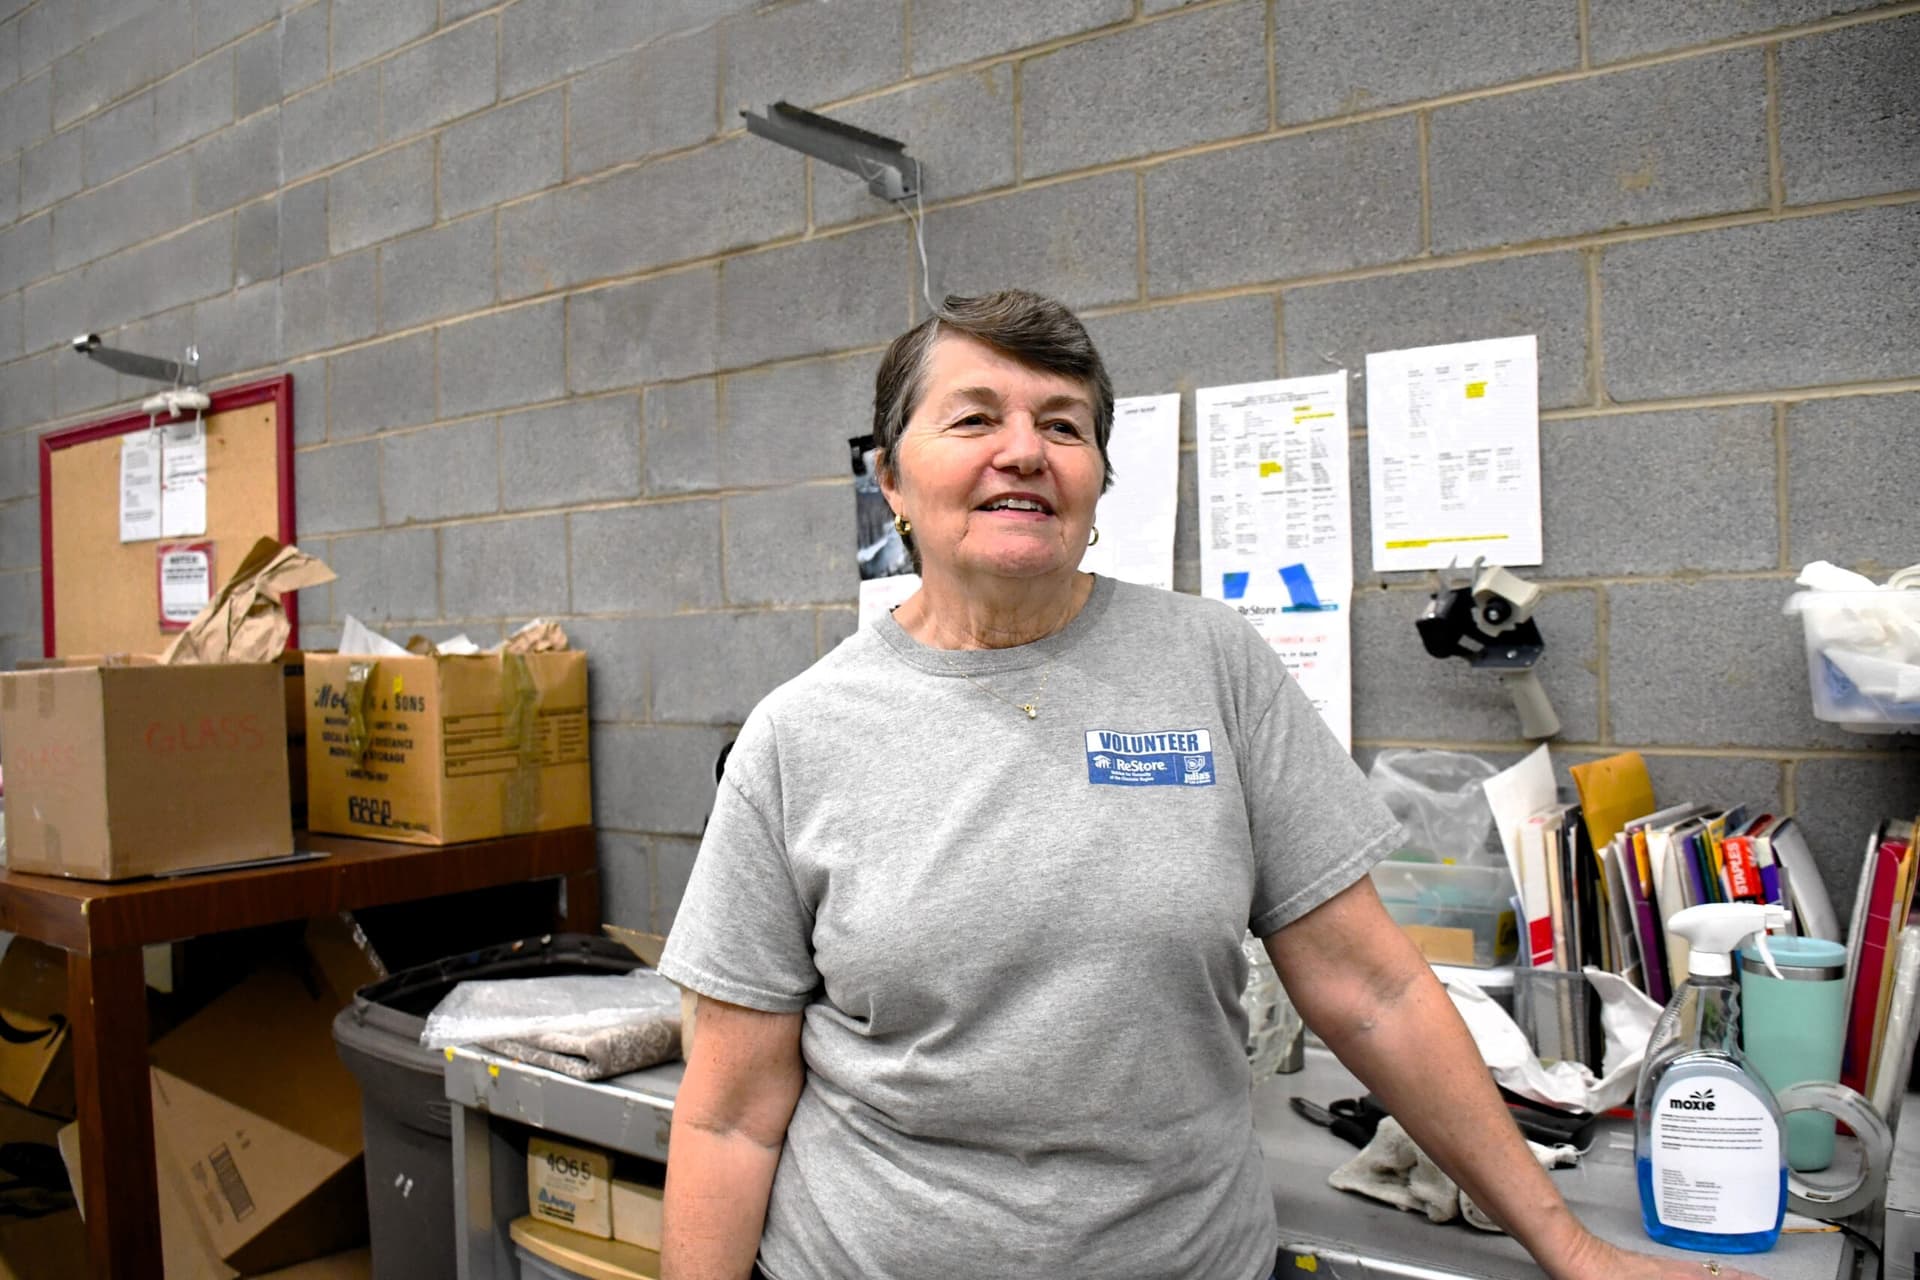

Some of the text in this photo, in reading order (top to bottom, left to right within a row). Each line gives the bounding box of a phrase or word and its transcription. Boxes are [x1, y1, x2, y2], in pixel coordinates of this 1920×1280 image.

[394, 692, 425, 712] SONS
[144, 713, 266, 754] GLASS
[1099, 732, 1200, 753] VOLUNTEER
[1116, 758, 1166, 772] ReStore
[1725, 842, 1749, 895] STAPLES
[1670, 1098, 1716, 1111] moxie
[547, 1154, 592, 1180] 4065
